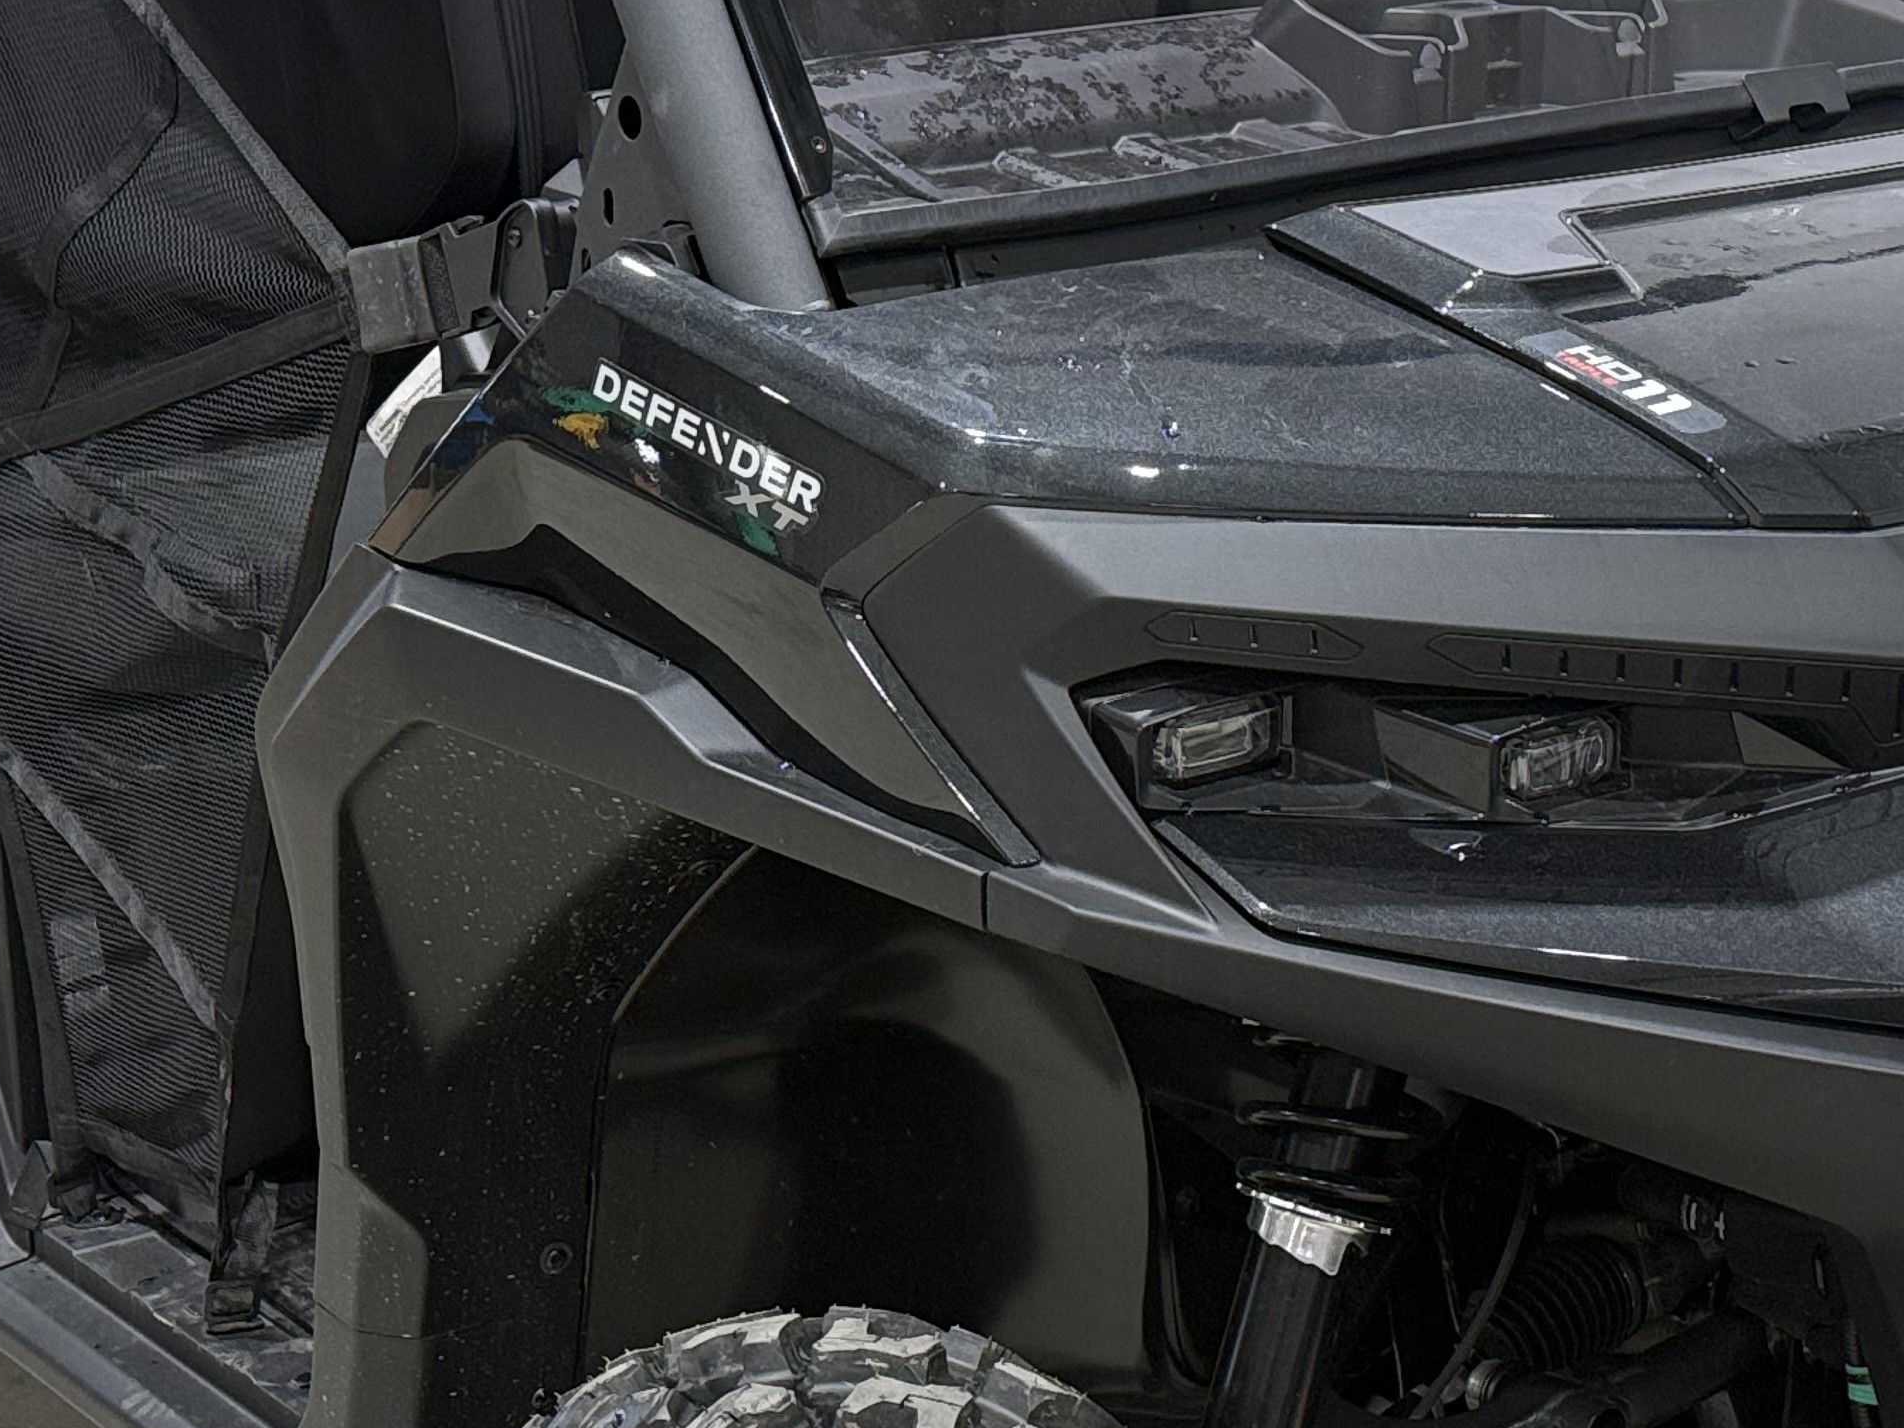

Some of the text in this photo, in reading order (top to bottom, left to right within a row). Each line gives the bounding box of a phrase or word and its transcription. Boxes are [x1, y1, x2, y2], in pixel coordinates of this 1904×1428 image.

[1563, 344, 1693, 416] HD11
[592, 363, 822, 514] DEFENDER
[724, 479, 809, 531] XT
